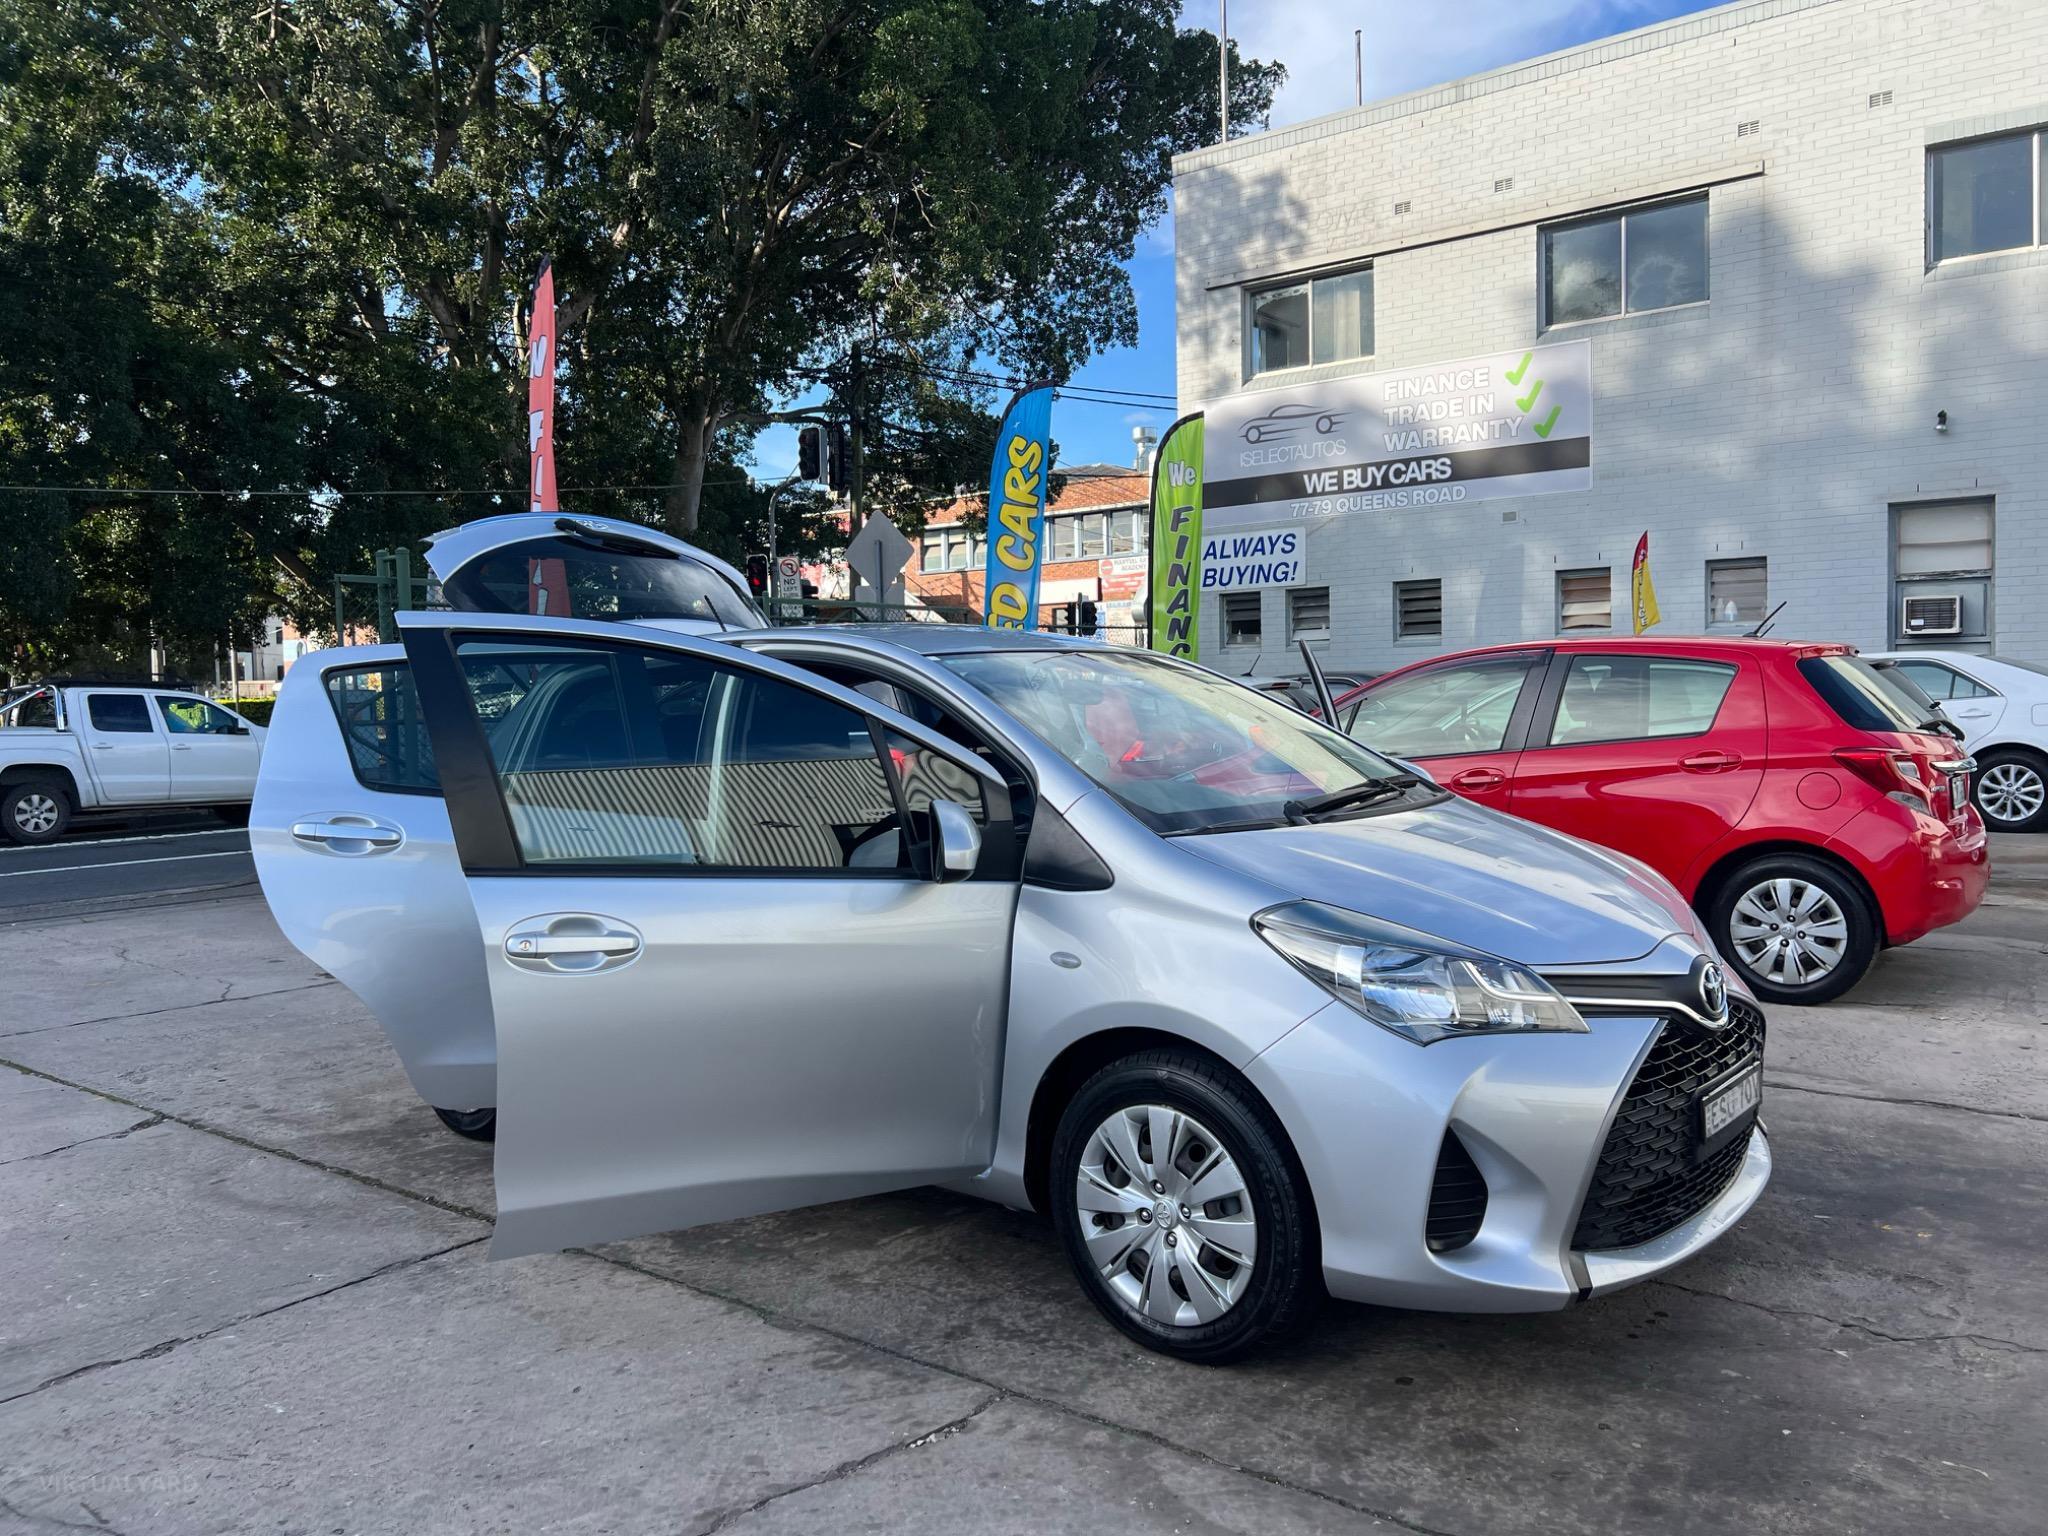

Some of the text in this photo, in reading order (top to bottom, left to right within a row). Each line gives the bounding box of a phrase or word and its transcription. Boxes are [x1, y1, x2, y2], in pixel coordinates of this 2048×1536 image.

[1384, 367, 1490, 400] FINANCE
[1383, 392, 1495, 427] TRADE IN
[1383, 416, 1525, 452] WARRANTY
[1167, 459, 1197, 488] We
[1302, 457, 1453, 495] WE BUY CARS
[996, 434, 1043, 572] CARS
[1289, 485, 1467, 518] 77-79 QUEENS ROAD
[1202, 533, 1297, 561] ALWAYS
[1202, 561, 1298, 588] BUYING!
